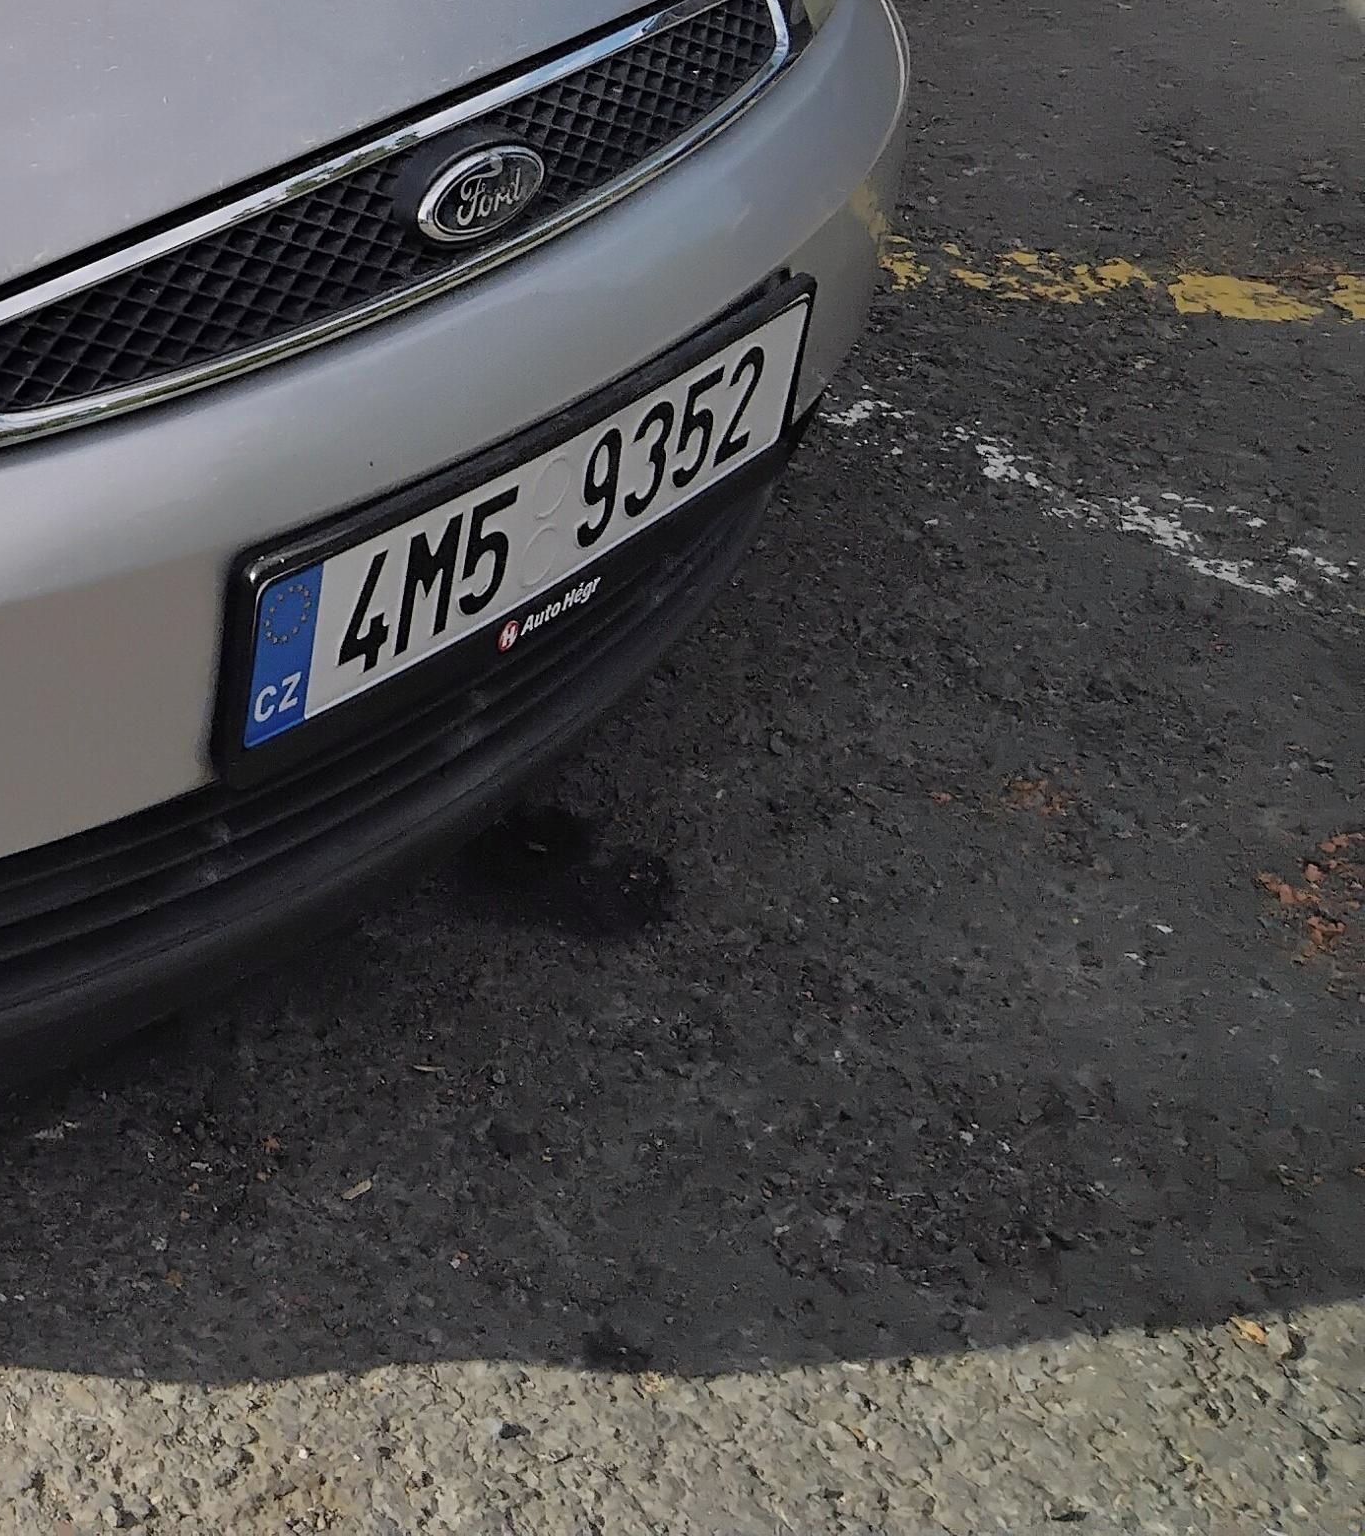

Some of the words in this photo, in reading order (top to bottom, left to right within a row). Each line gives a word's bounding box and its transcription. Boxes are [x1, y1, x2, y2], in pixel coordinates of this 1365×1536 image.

[457, 156, 521, 226] Ford
[335, 485, 518, 673] 4M5
[576, 345, 766, 548] 9352
[253, 672, 302, 722] CZ
